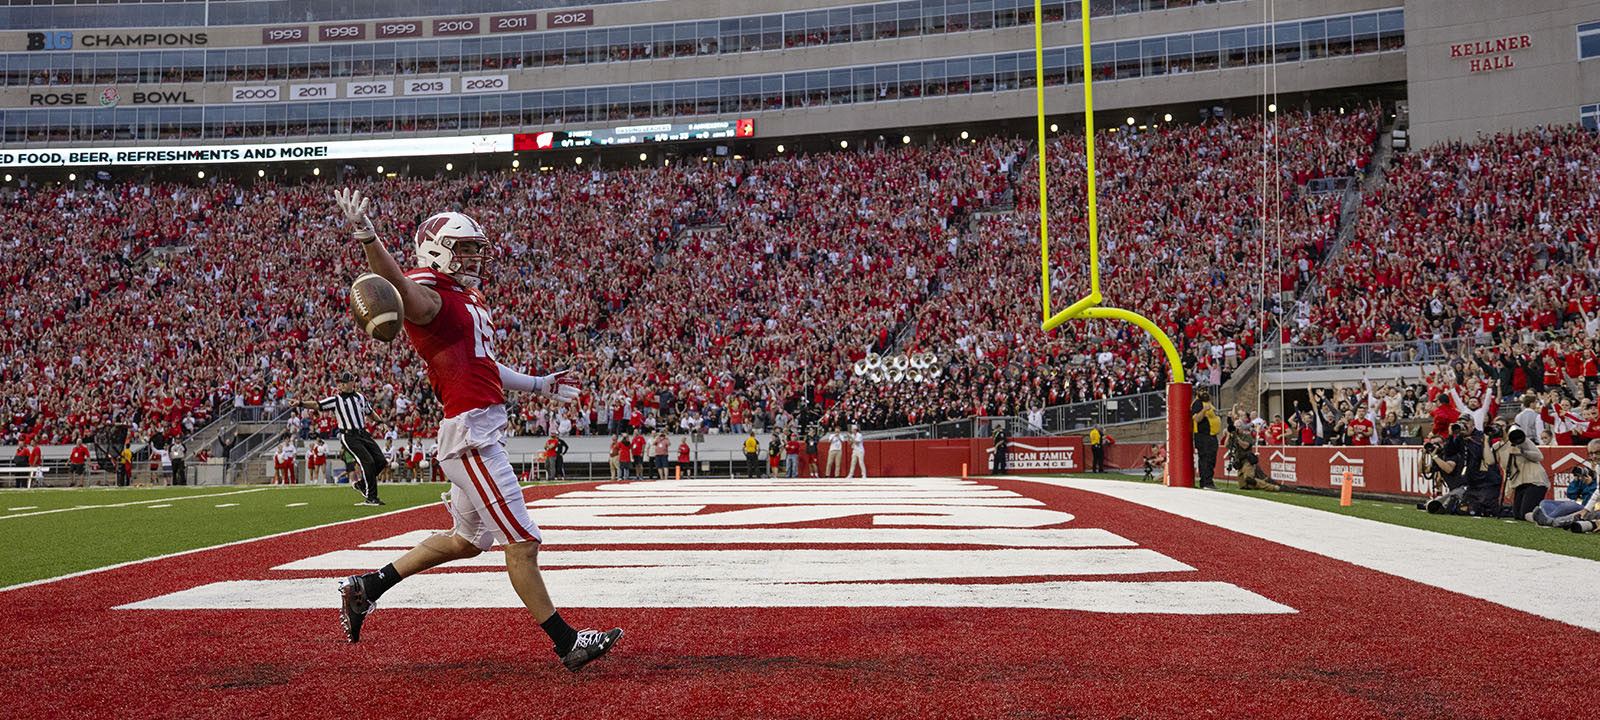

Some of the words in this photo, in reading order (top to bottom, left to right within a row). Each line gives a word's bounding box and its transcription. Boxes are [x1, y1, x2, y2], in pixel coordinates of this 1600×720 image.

[498, 18, 527, 28] 2011
[554, 13, 586, 24] 2012
[381, 24, 416, 34] 1999
[438, 21, 473, 32] 2010
[269, 30, 302, 40] 1993
[325, 27, 359, 37] 1998
[81, 33, 208, 47] CHAMPIONS
[1450, 35, 1532, 57] KELLNER
[1470, 55, 1514, 72] HALL
[411, 82, 444, 92] 2013
[467, 79, 504, 89] 2020
[236, 89, 277, 99] 2000
[299, 87, 327, 97] 2011
[354, 85, 386, 95] 2012
[30, 93, 87, 105] ROSE
[133, 92, 194, 104] BOWL
[18, 153, 65, 166] FOOD,
[69, 152, 113, 165] BEER,
[117, 149, 240, 162] REFRESHMENTS
[243, 148, 276, 159] AND
[280, 146, 328, 158] MORE!
[988, 452, 1037, 461] AERICAN
[1040, 452, 1073, 460] FAMILY
